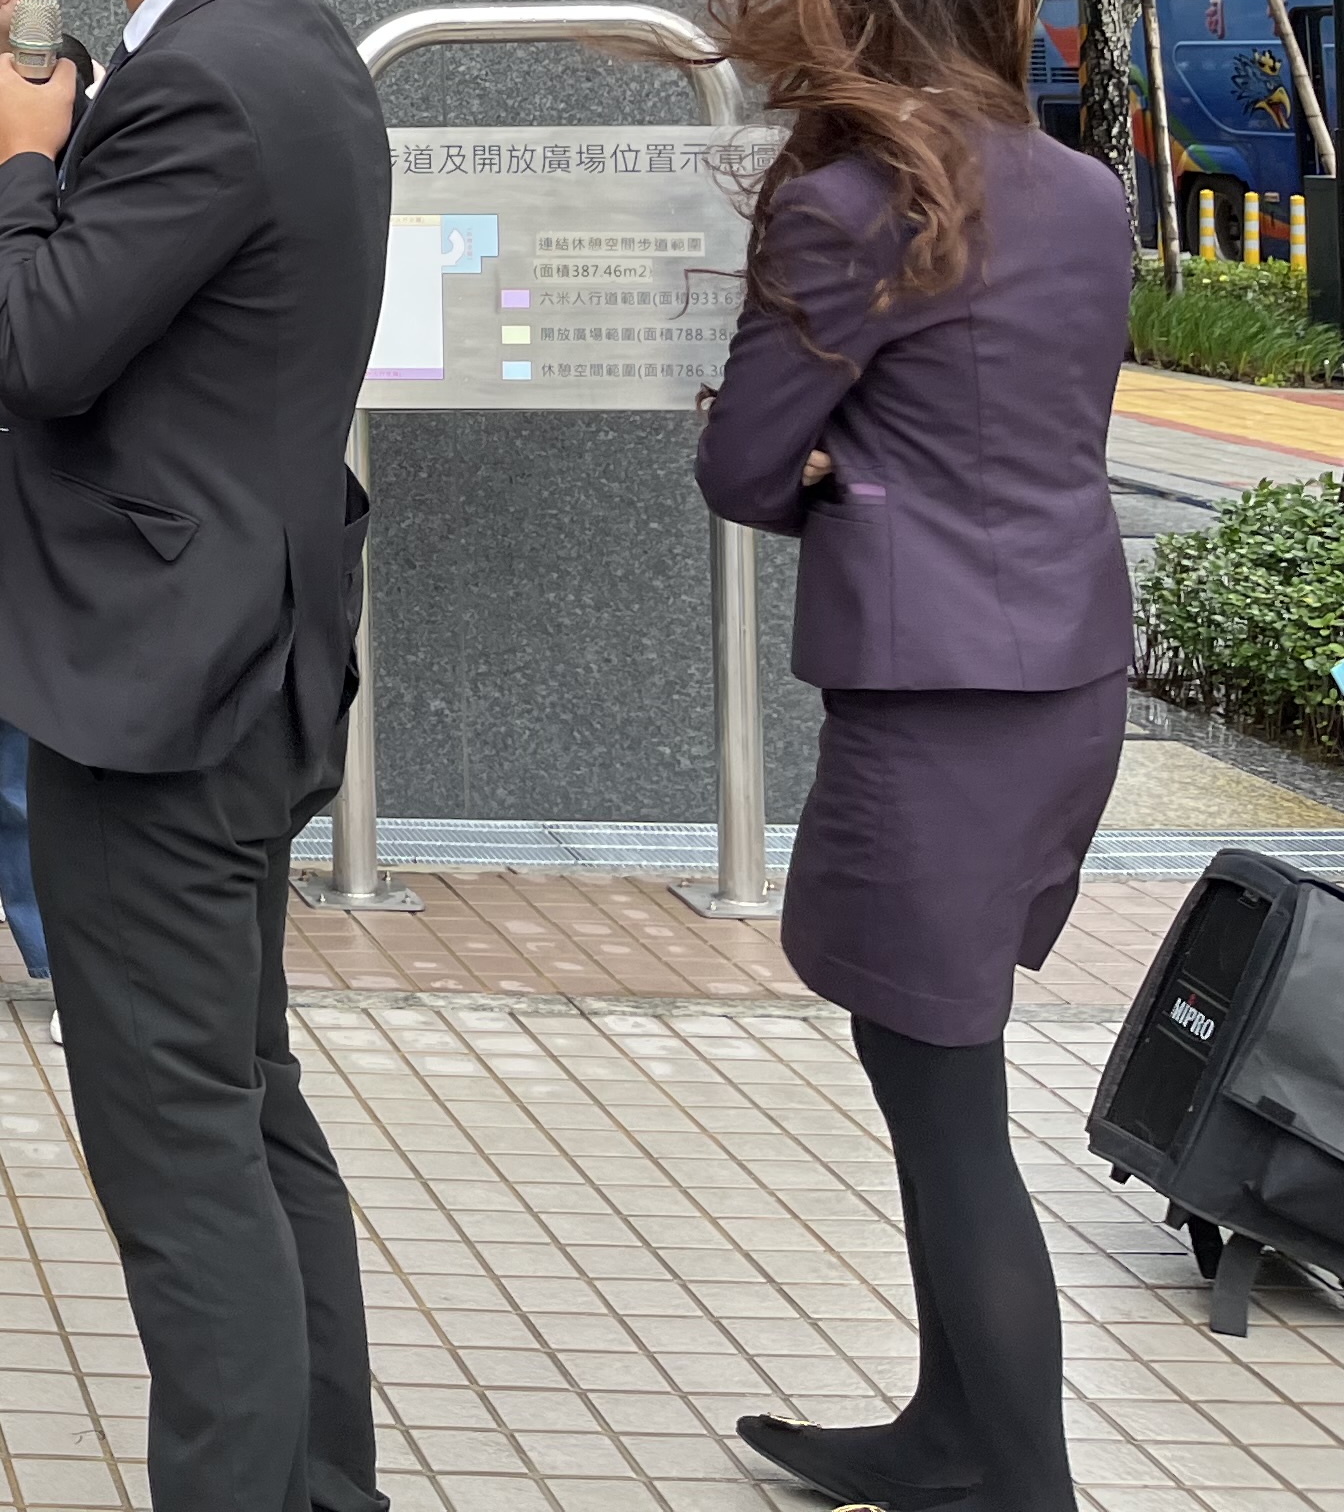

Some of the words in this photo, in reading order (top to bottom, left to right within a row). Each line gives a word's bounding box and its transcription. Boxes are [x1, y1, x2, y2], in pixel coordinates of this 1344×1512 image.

[538, 236, 702, 253] 連結休憩空間步道範圍
[1170, 997, 1215, 1040] MIPRO
